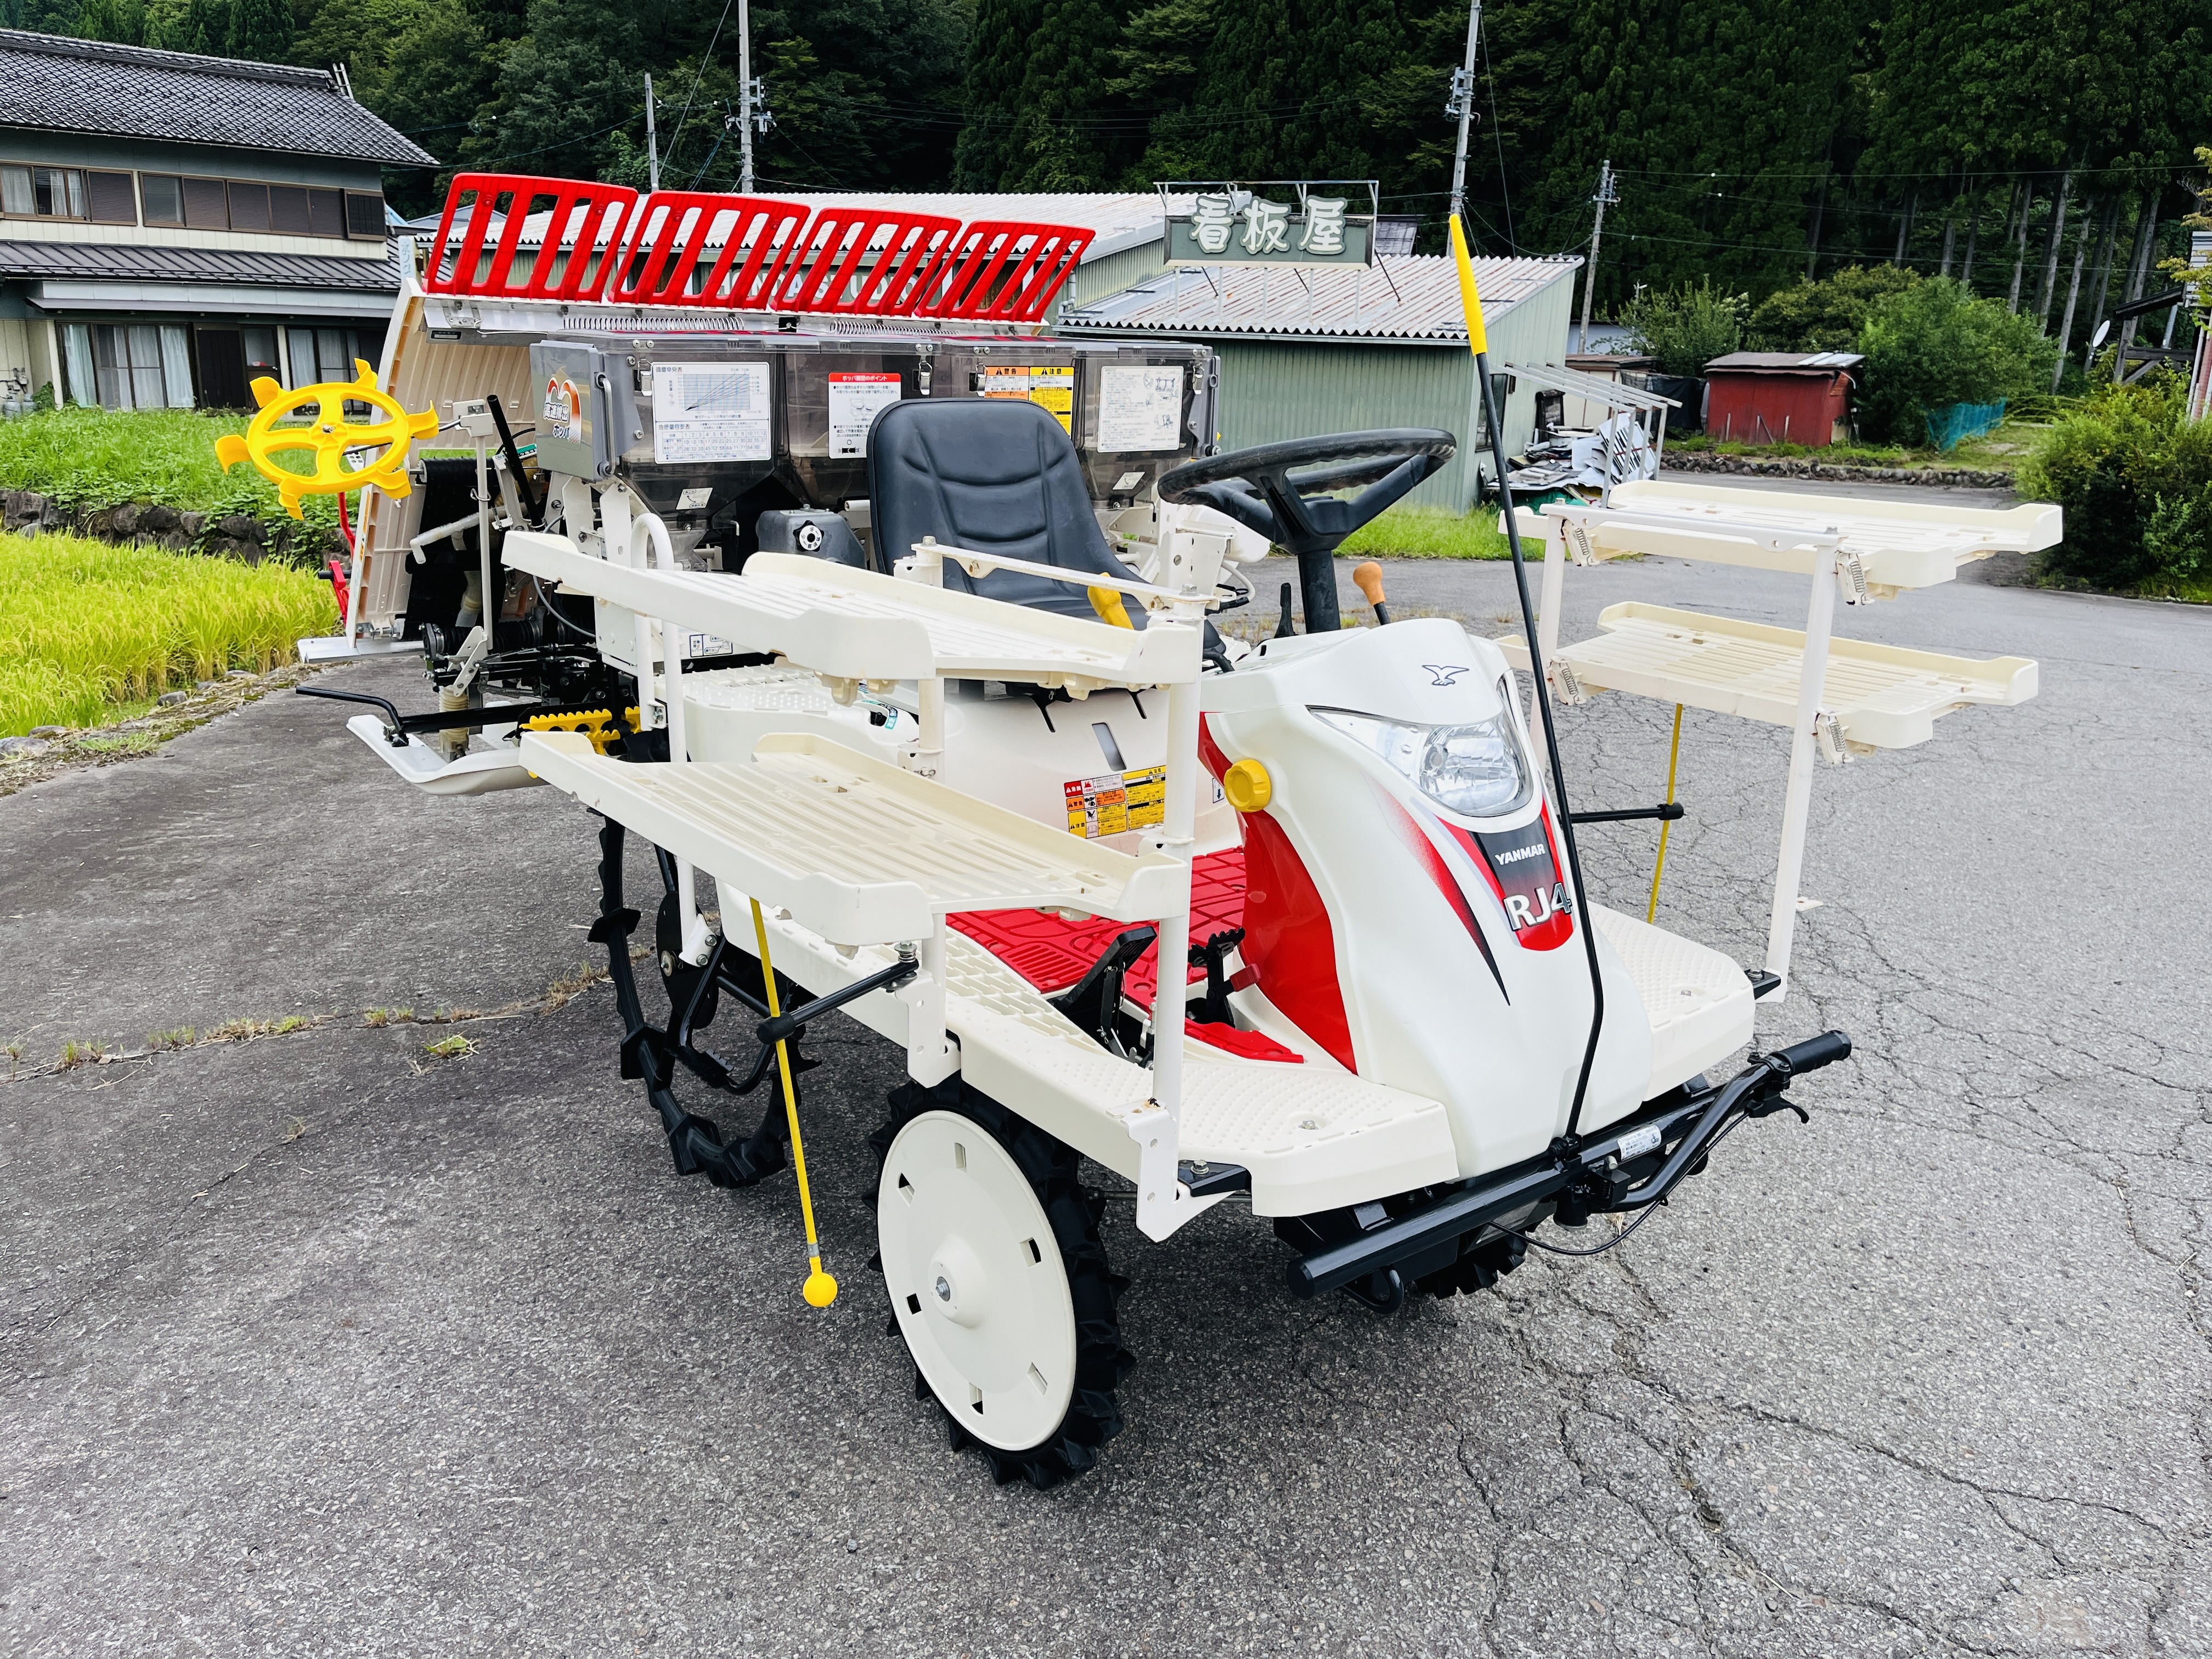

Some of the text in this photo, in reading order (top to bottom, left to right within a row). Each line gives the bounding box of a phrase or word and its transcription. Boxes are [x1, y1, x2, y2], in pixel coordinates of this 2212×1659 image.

[1190, 196, 1346, 253] 看板屋
[1494, 843, 1546, 865] YANMAR
[1503, 882, 1572, 932] RJ4
